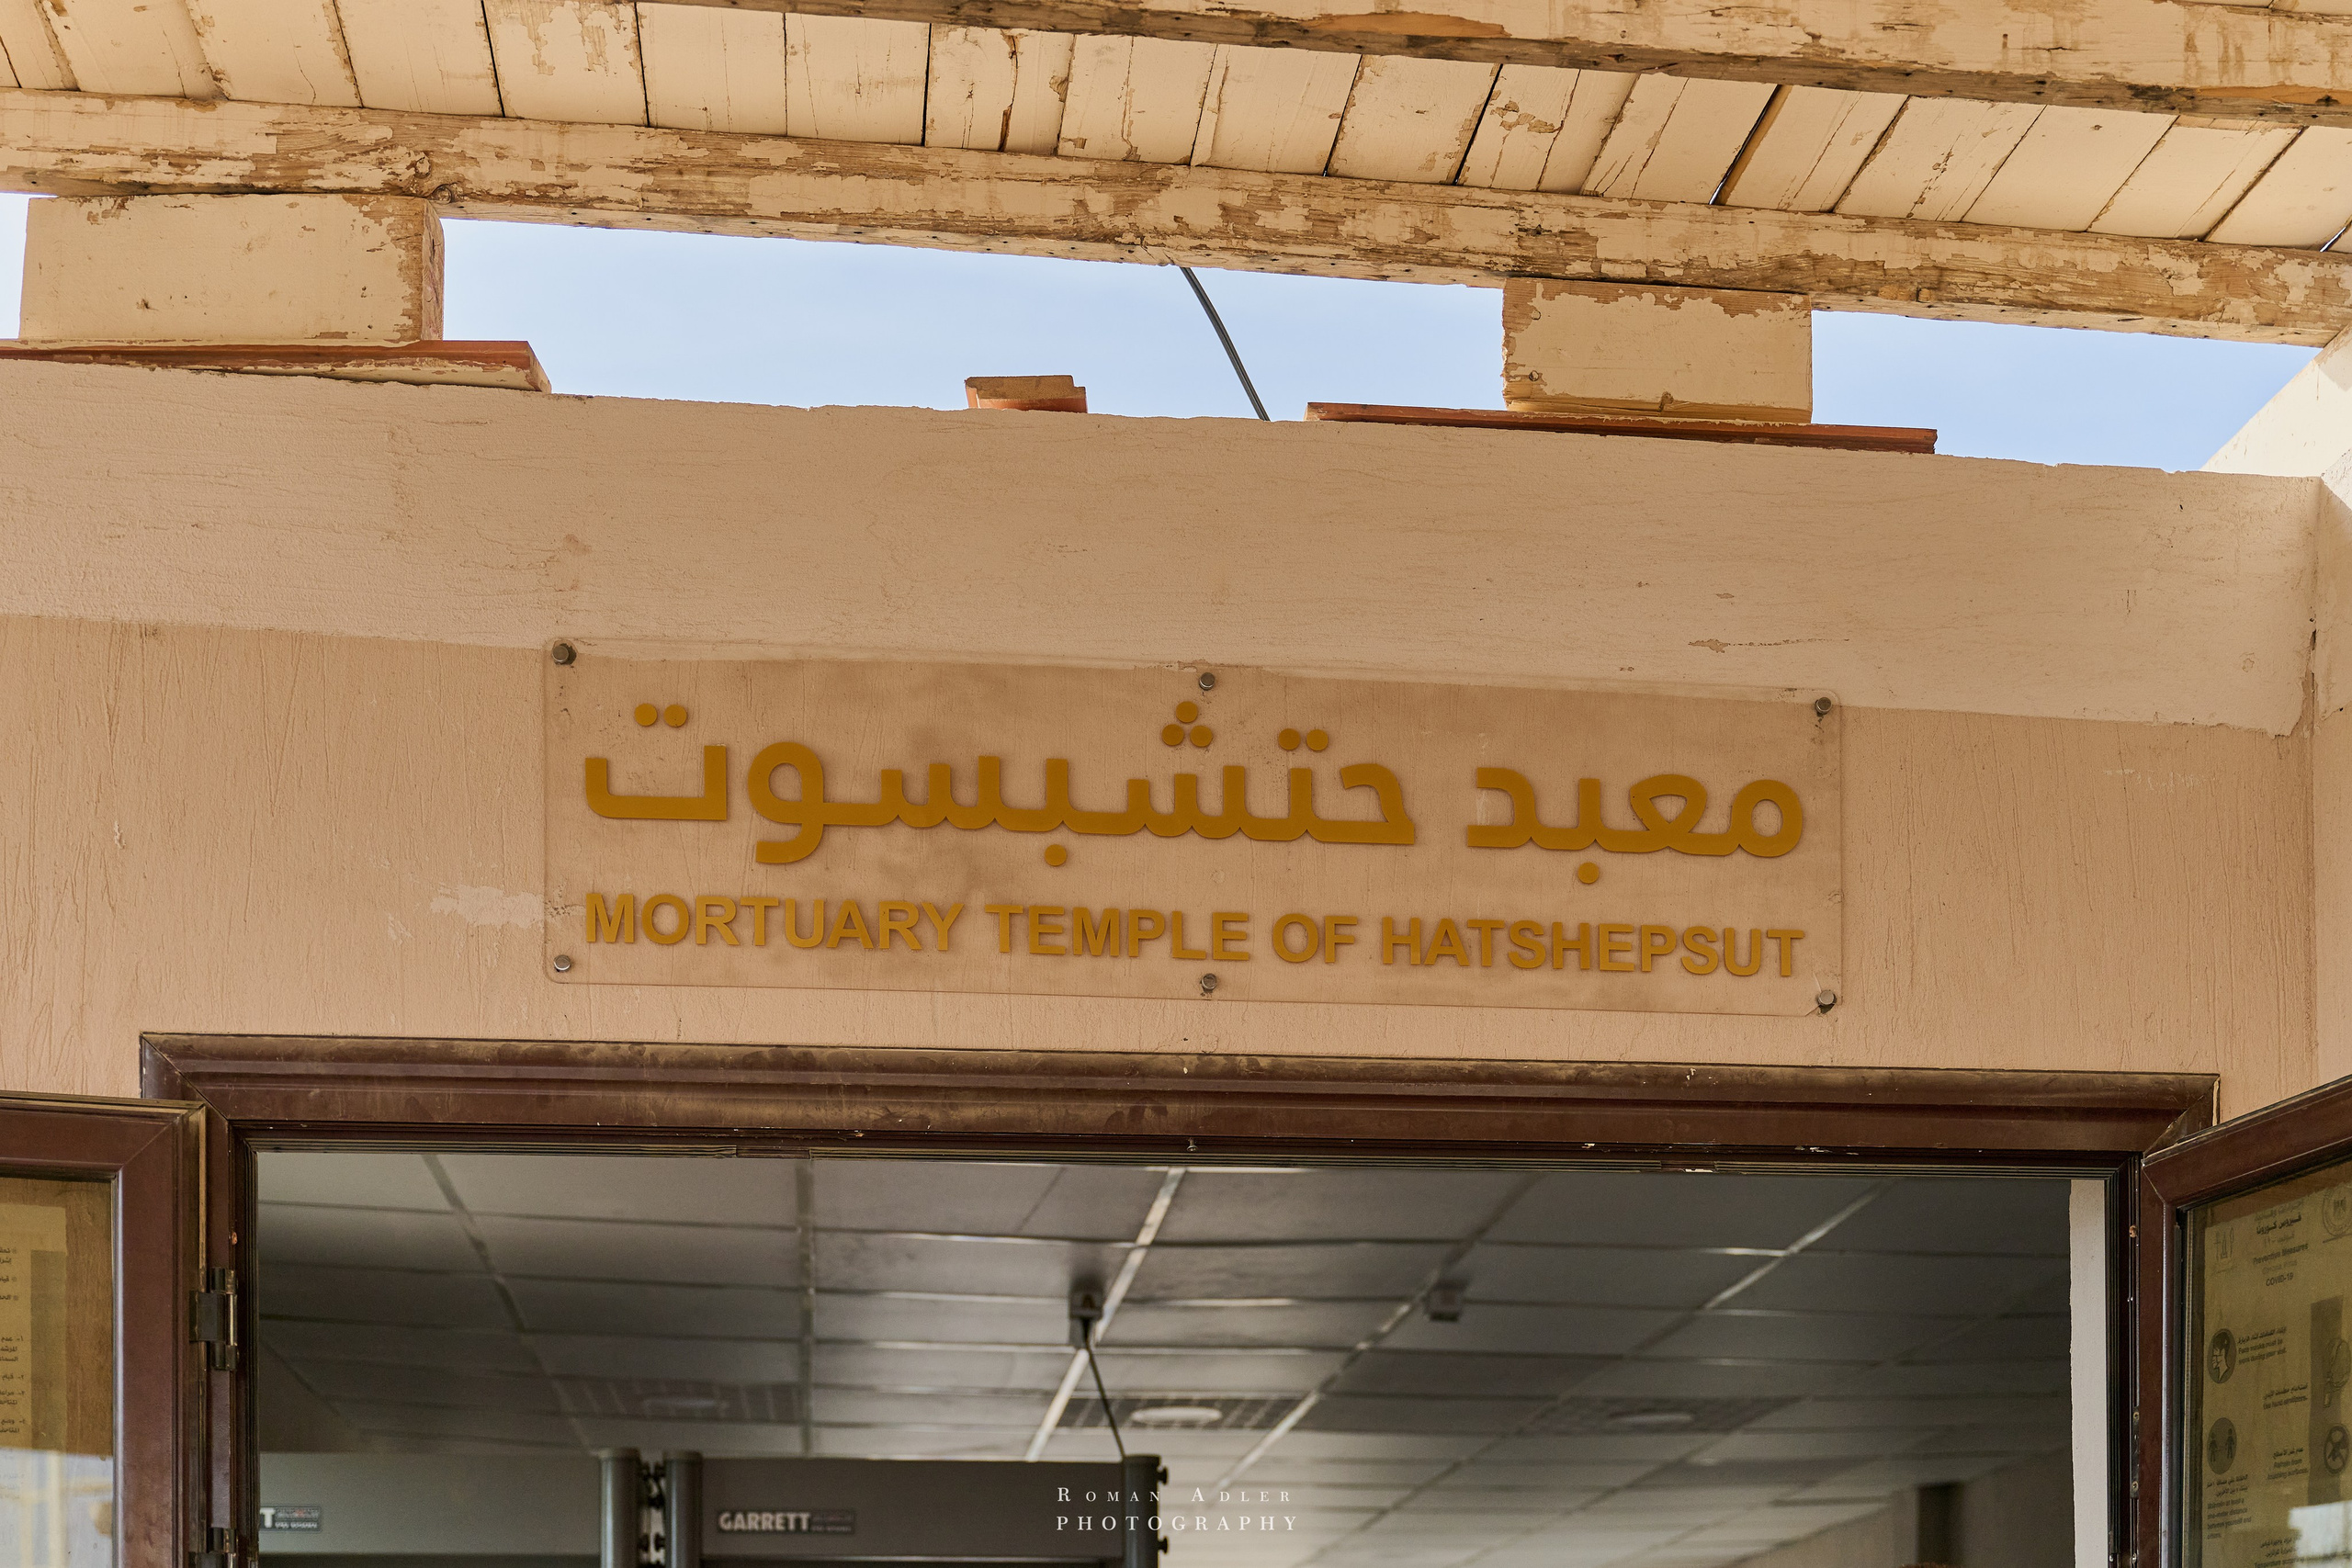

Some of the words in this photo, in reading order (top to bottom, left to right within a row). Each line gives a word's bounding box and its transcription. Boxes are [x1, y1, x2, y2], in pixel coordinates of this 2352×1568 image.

[584, 701, 1414, 866] حتشبسوت
[1467, 767, 1803, 884] معبد
[584, 892, 964, 952] MORTUARY
[984, 902, 1250, 962] TEMPLE
[1272, 912, 1358, 964] OF
[1382, 916, 1805, 977] HATSHEPSUT
[2281, 1243, 2309, 1257] Measures
[2266, 1271, 2294, 1287] COVID-19
[718, 1511, 811, 1531] GARRETT
